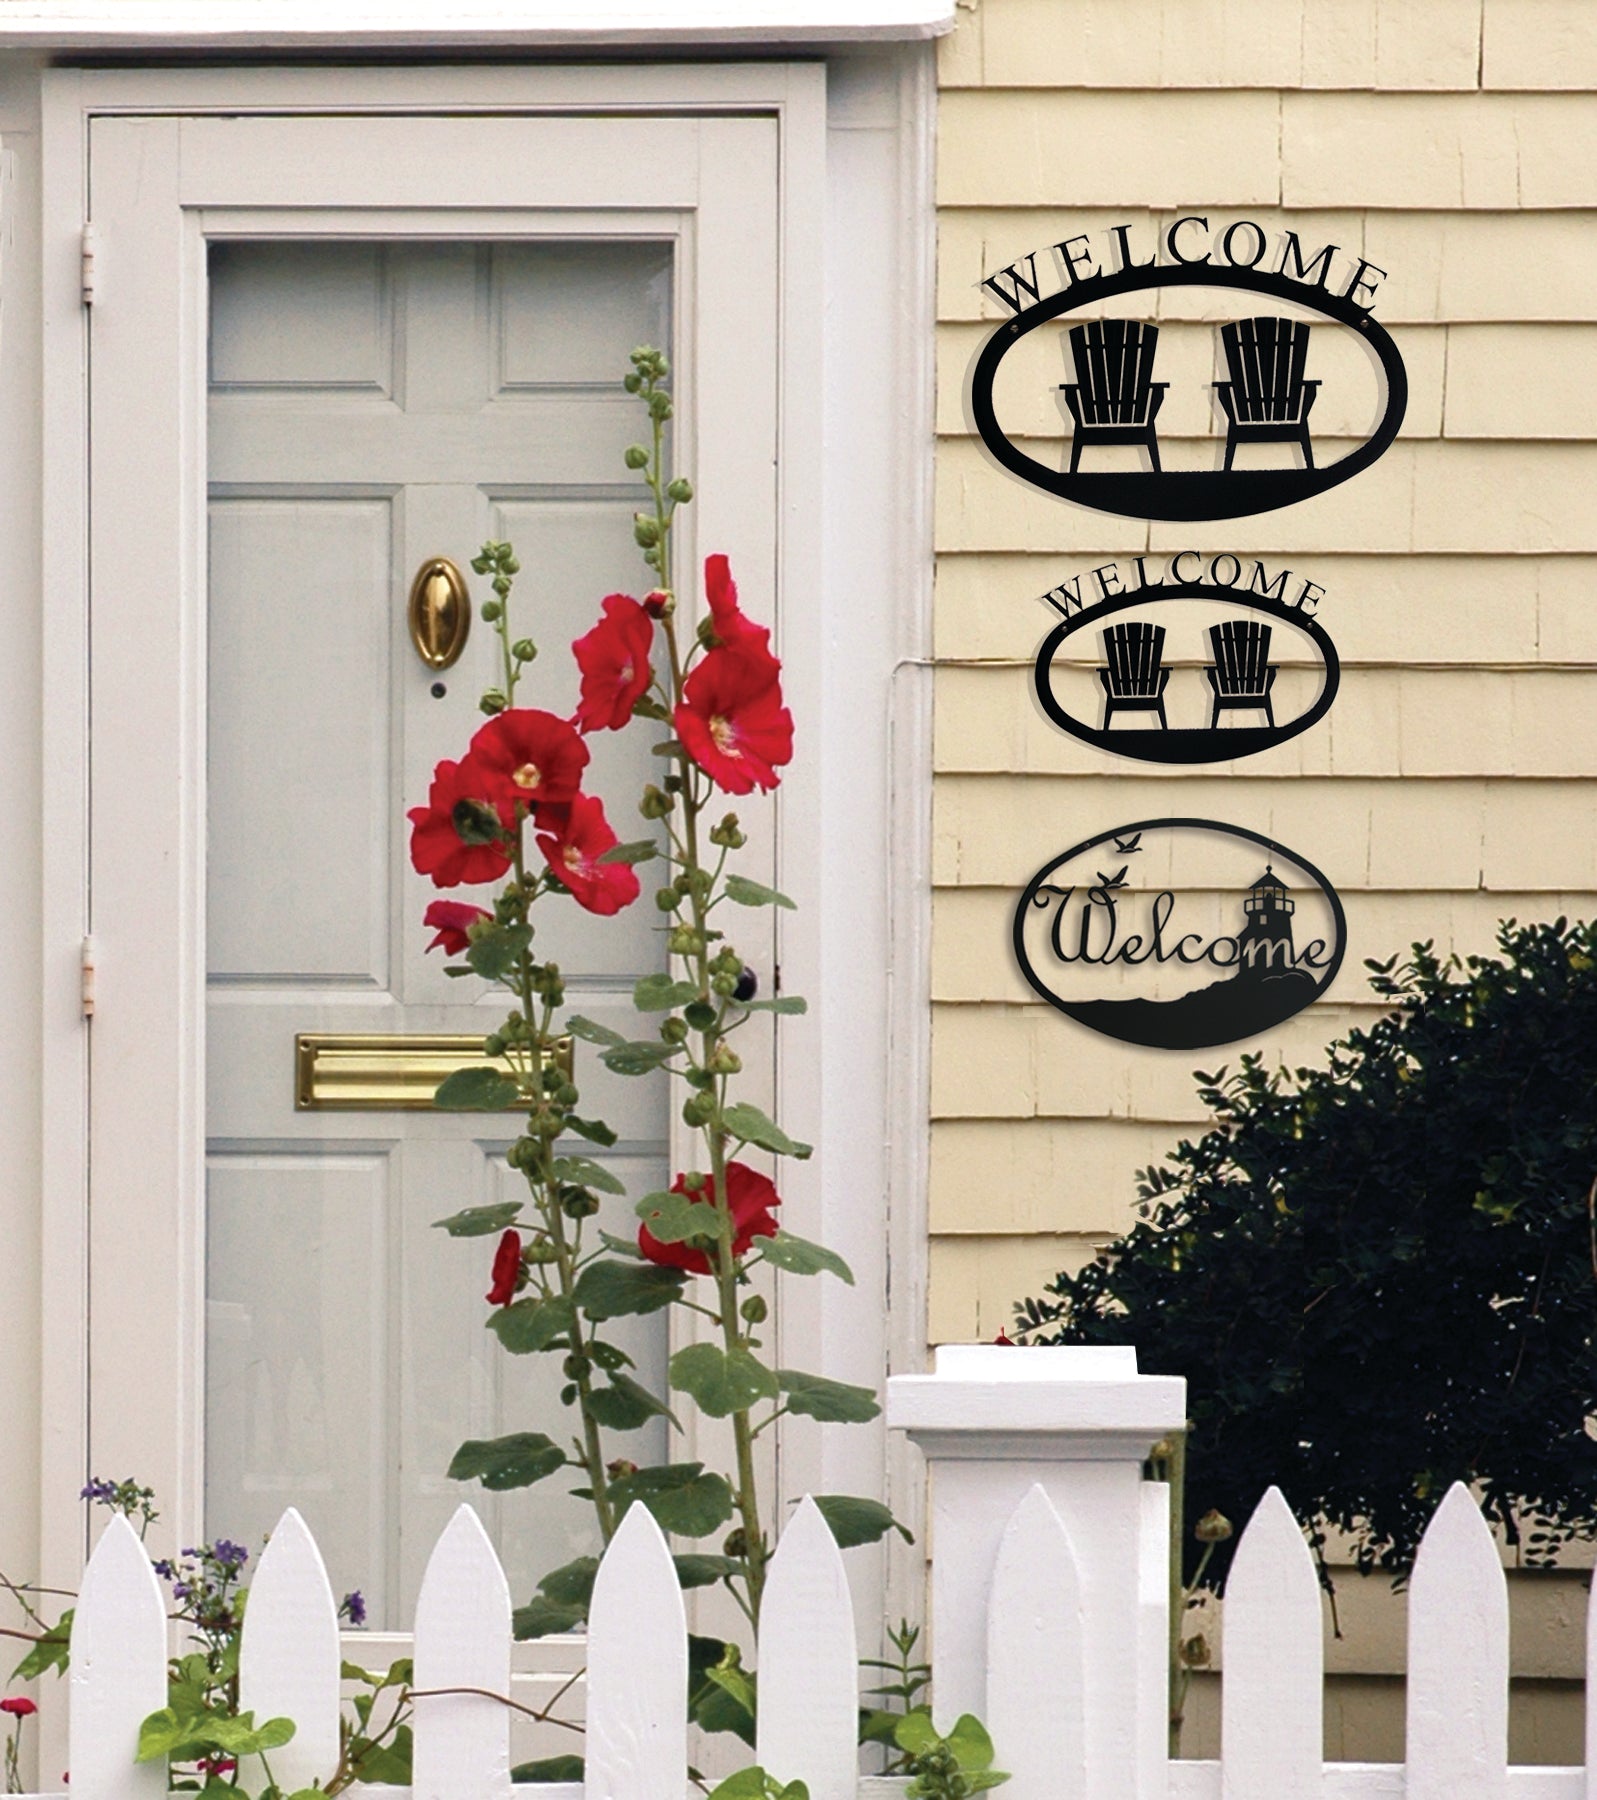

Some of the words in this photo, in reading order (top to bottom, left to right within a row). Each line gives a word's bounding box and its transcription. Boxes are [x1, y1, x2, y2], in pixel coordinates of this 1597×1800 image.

[982, 216, 1388, 315] WELCOME
[1041, 550, 1327, 619] WELCOME
[1032, 885, 1332, 969] Welcome
